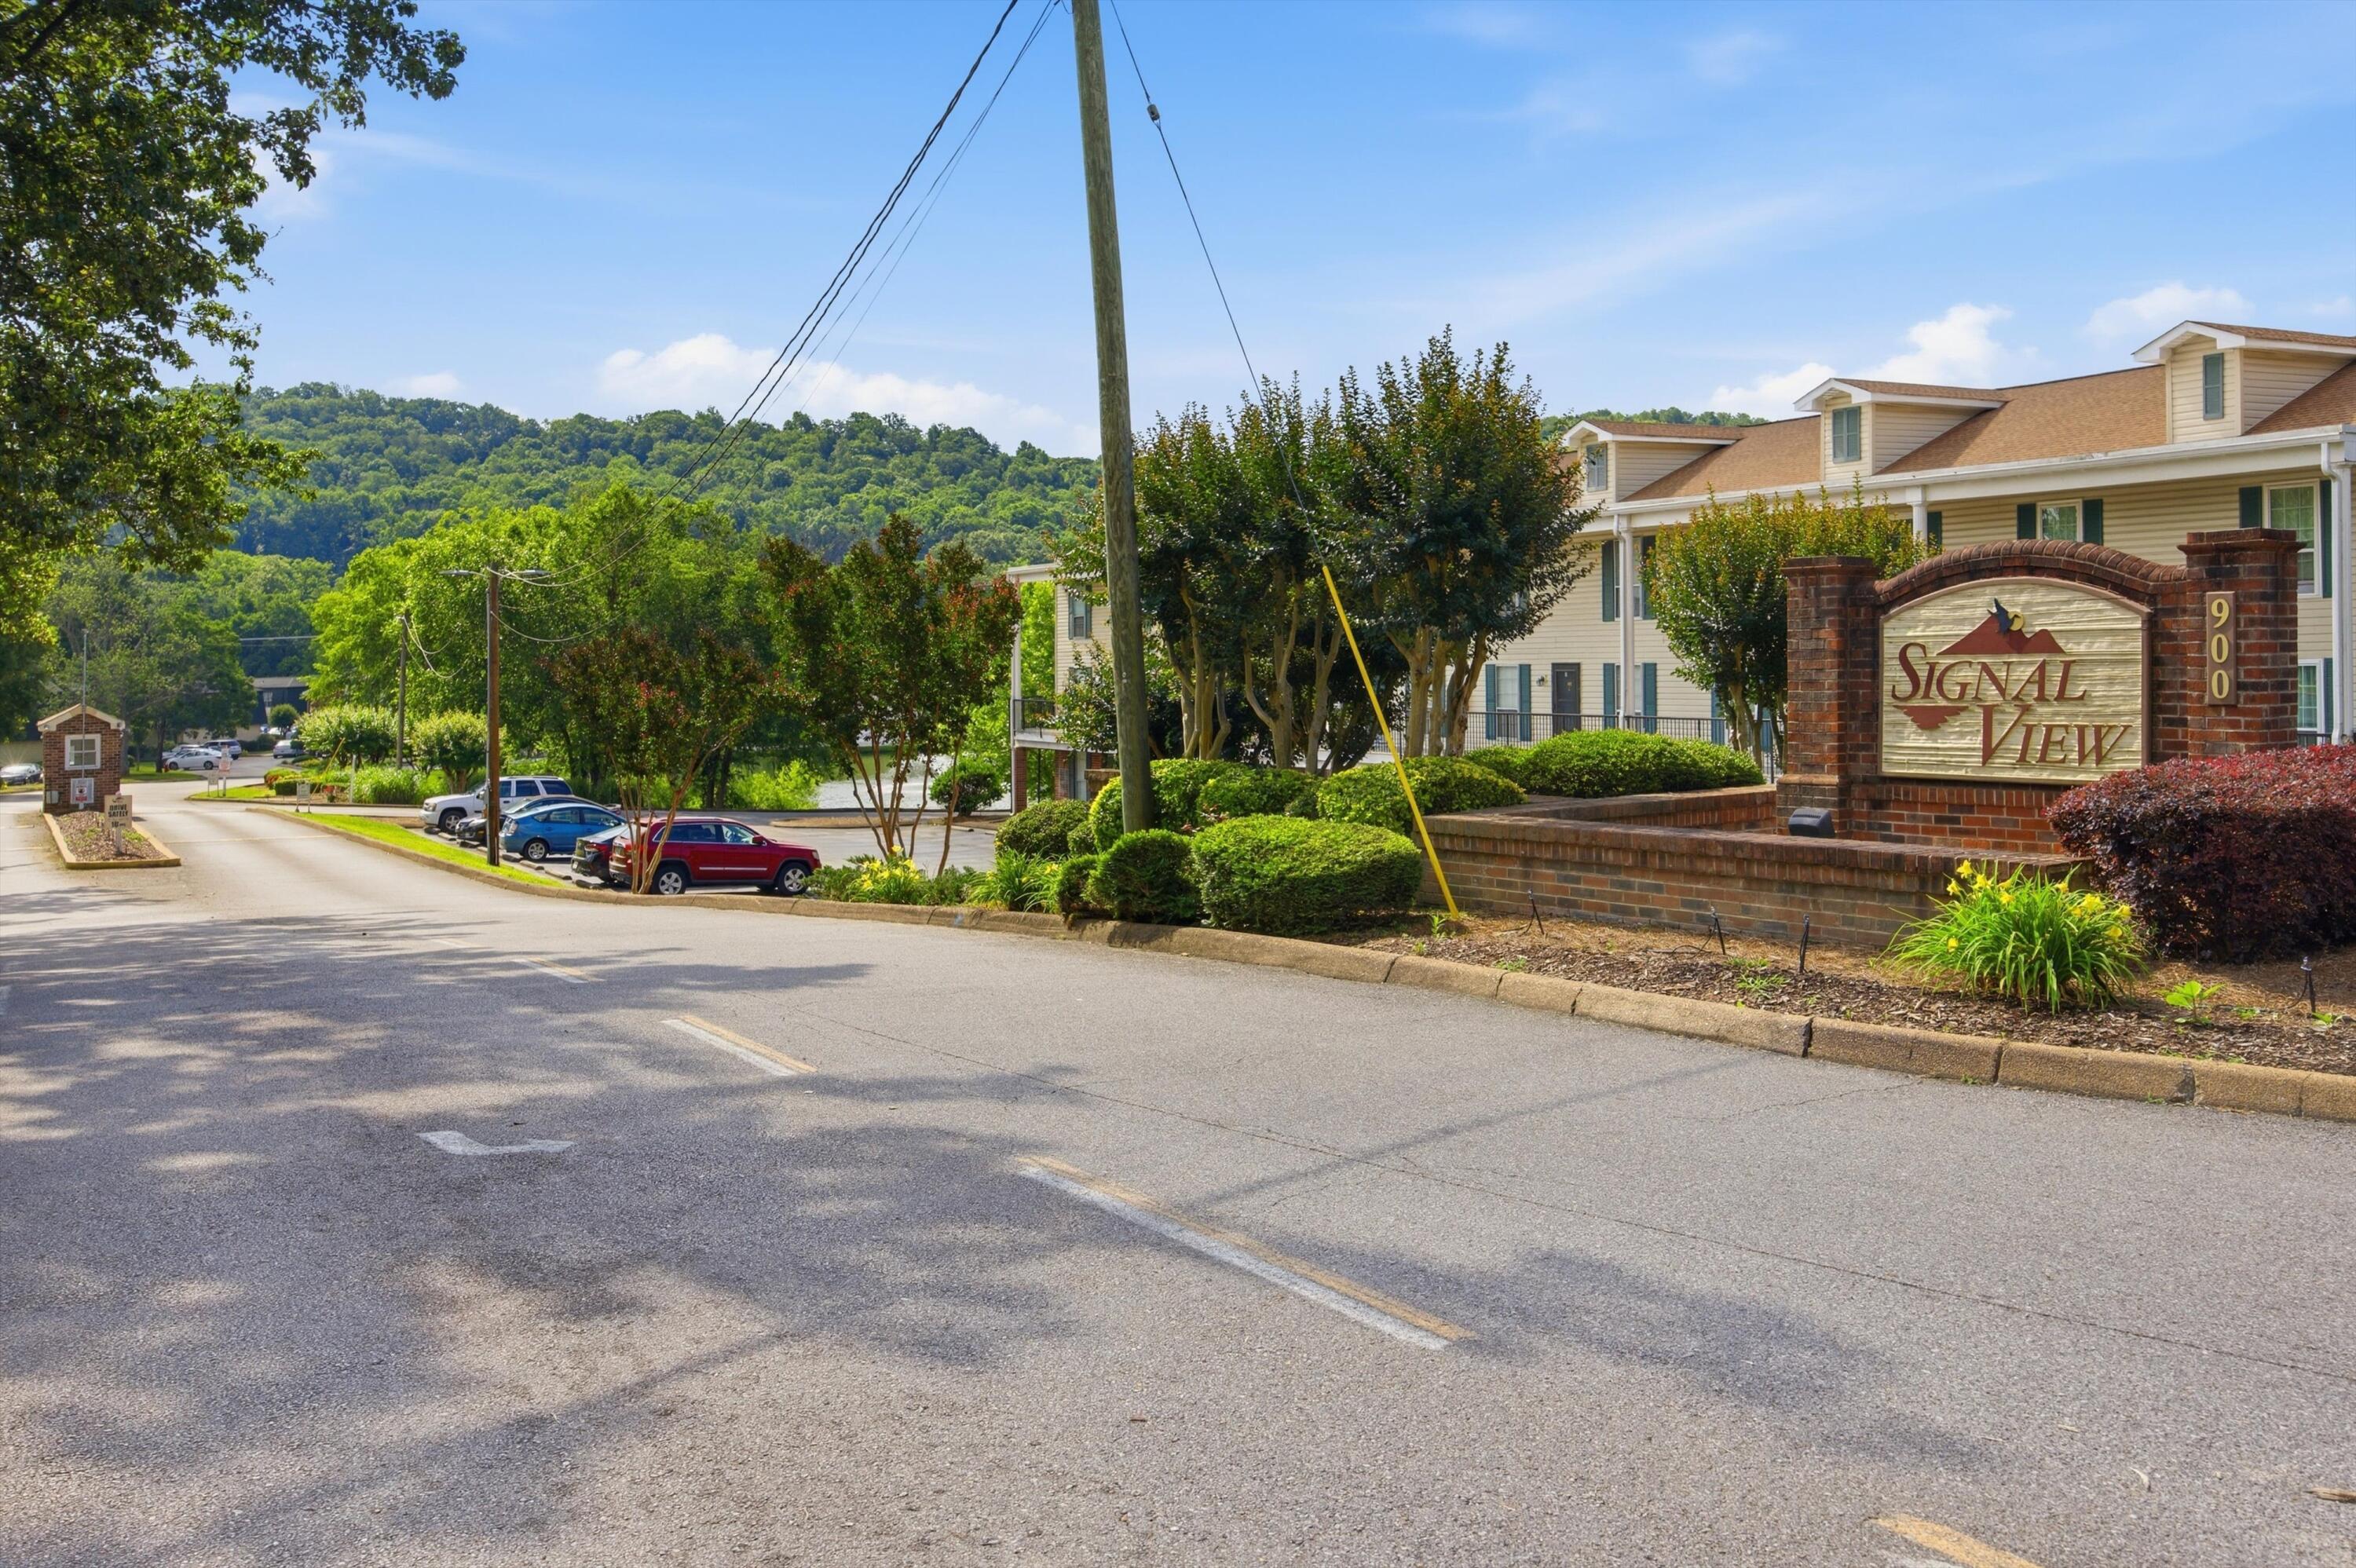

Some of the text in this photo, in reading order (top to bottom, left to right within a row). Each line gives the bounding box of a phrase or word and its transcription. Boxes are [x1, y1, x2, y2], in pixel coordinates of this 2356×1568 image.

[1891, 642, 2087, 701] SIGNAL
[2211, 598, 2230, 699] 900
[1976, 704, 2133, 767] VIEW
